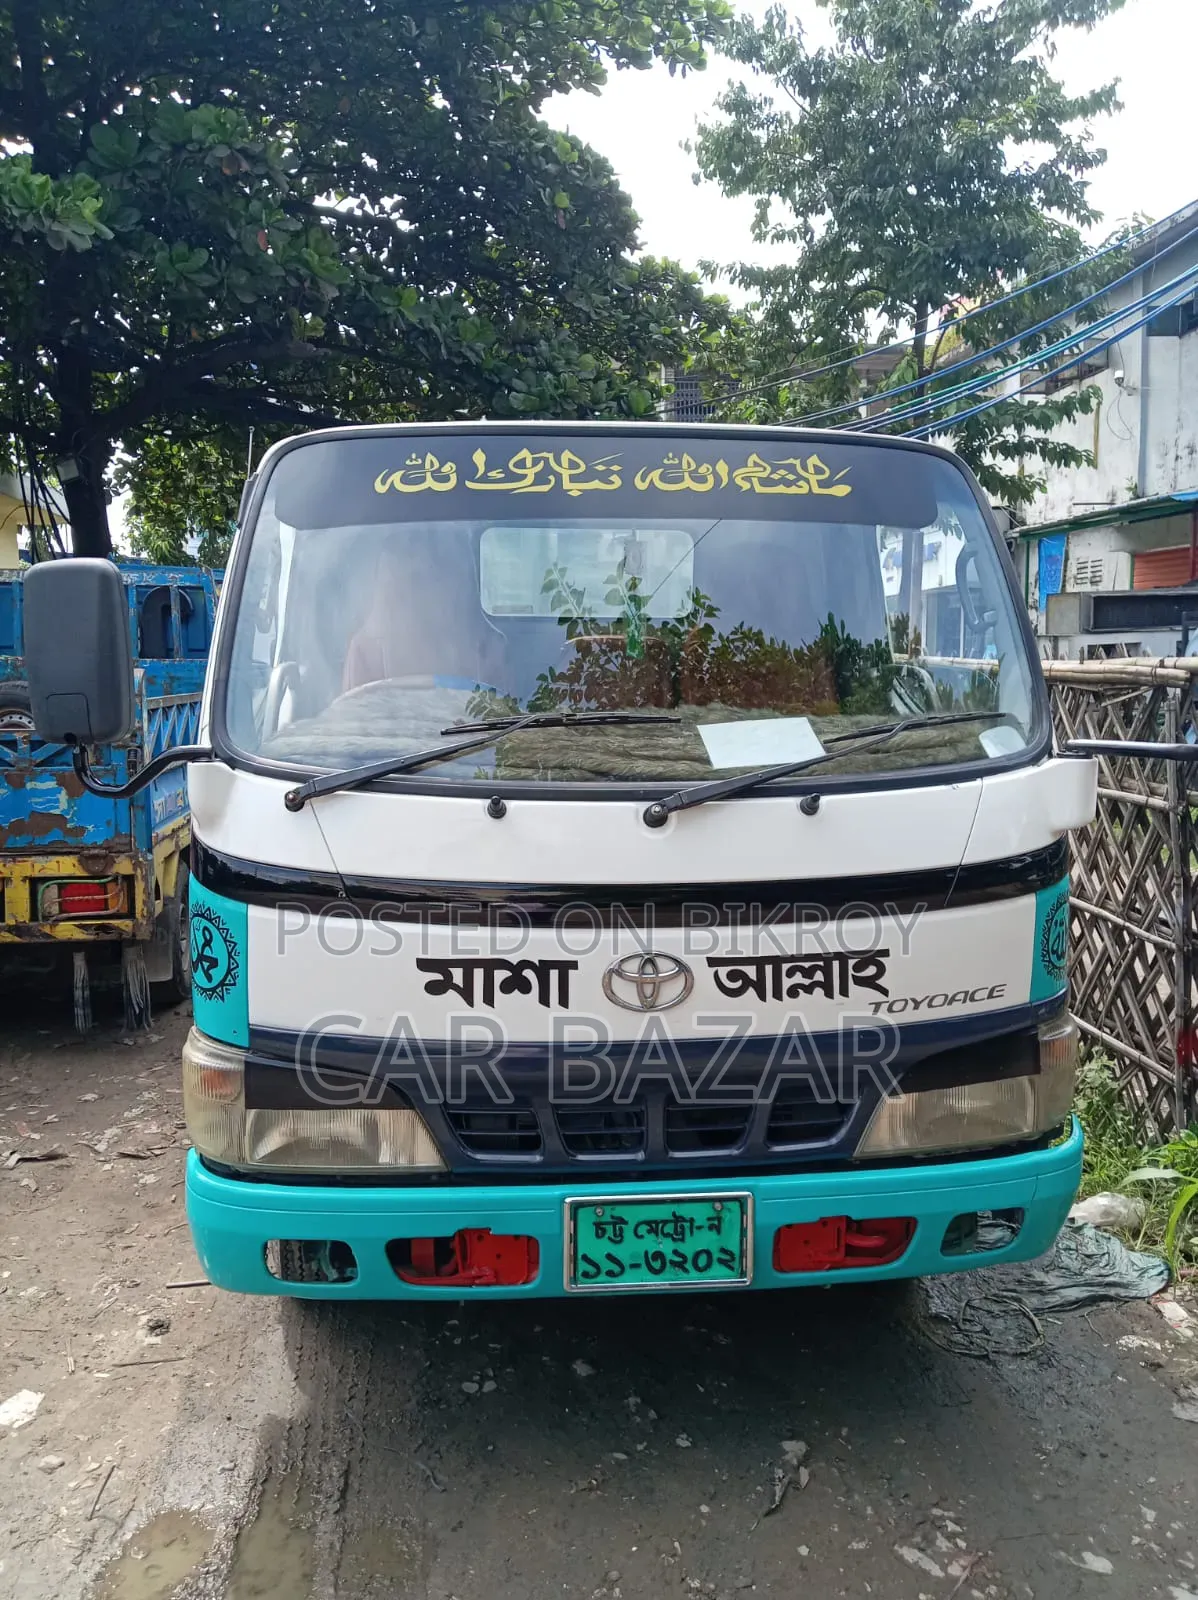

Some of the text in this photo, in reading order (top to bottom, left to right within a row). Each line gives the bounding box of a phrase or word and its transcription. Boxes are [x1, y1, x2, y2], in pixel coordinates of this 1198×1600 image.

[415, 948, 890, 1010] মাশা আল্লাহ
[868, 983, 1007, 1015] TOYOACE
[580, 1247, 736, 1279] ১১-৩২০২
